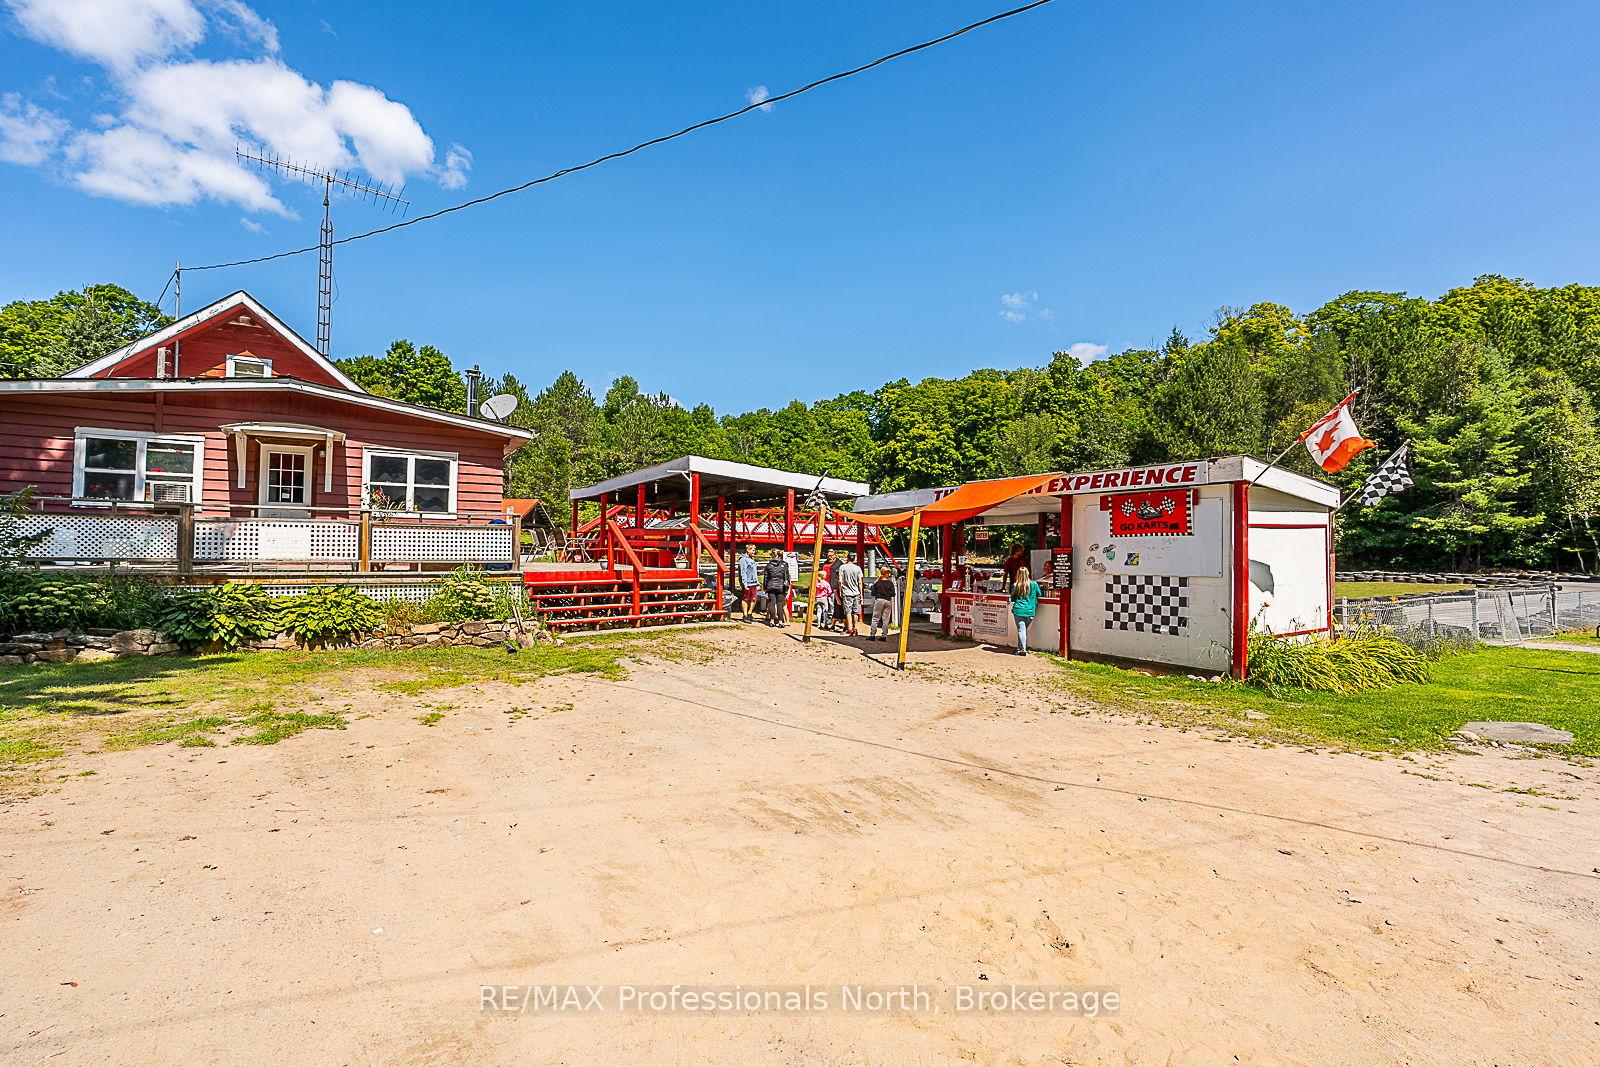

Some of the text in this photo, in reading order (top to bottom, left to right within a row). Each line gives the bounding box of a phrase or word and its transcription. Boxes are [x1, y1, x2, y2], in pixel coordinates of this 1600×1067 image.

[1046, 466, 1198, 492] EXPERIENCE
[1120, 521, 1169, 531] GO KARTS
